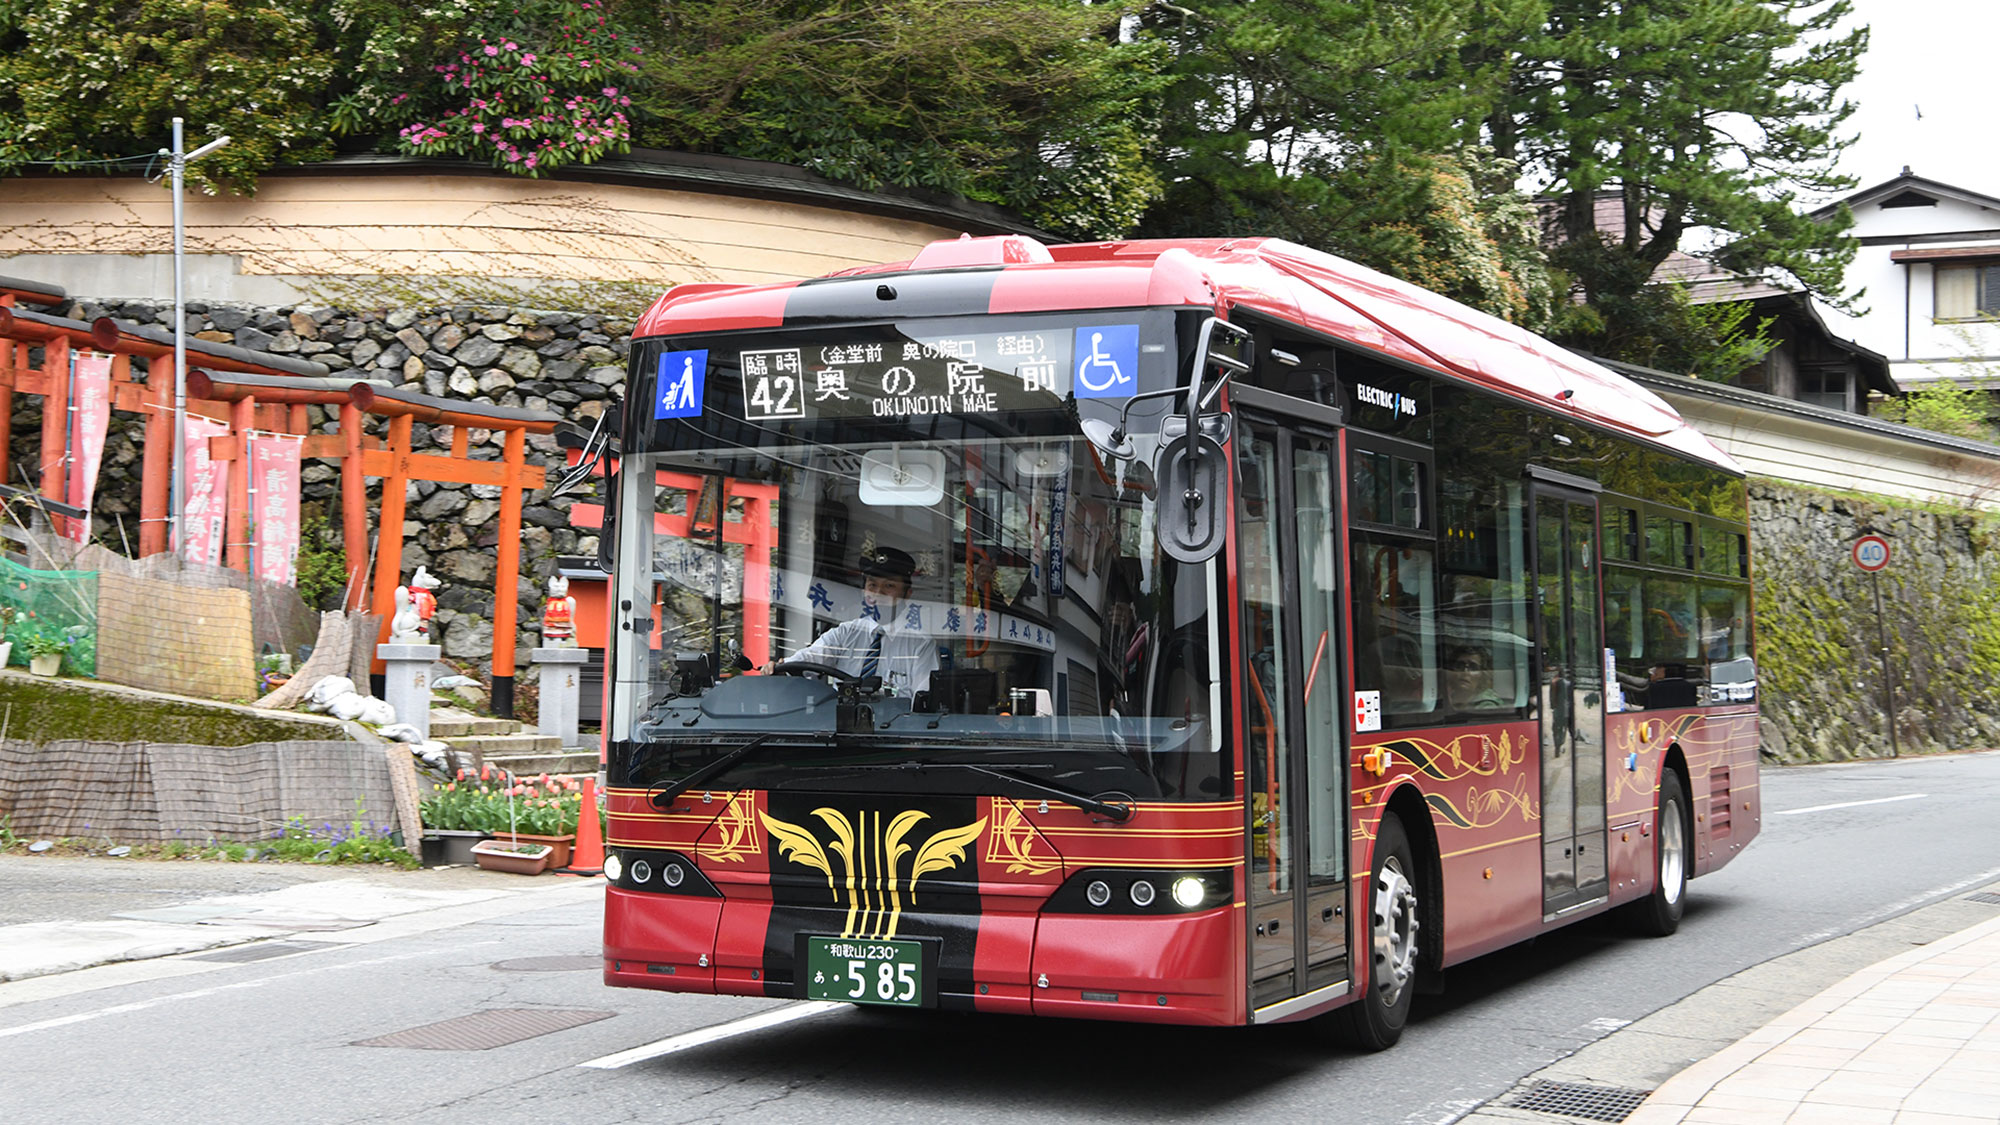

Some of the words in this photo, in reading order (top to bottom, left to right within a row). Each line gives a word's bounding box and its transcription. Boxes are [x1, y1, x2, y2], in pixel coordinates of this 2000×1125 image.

[902, 339, 976, 361] 奥の院口
[745, 352, 798, 376] 臨時
[750, 375, 798, 414] 42
[872, 395, 952, 416] OKUNOIN
[962, 393, 998, 413] MAE
[1357, 383, 1394, 409] ELECTRIC
[1400, 396, 1417, 416] BUS
[1861, 545, 1882, 561] 40
[813, 970, 825, 984] あ
